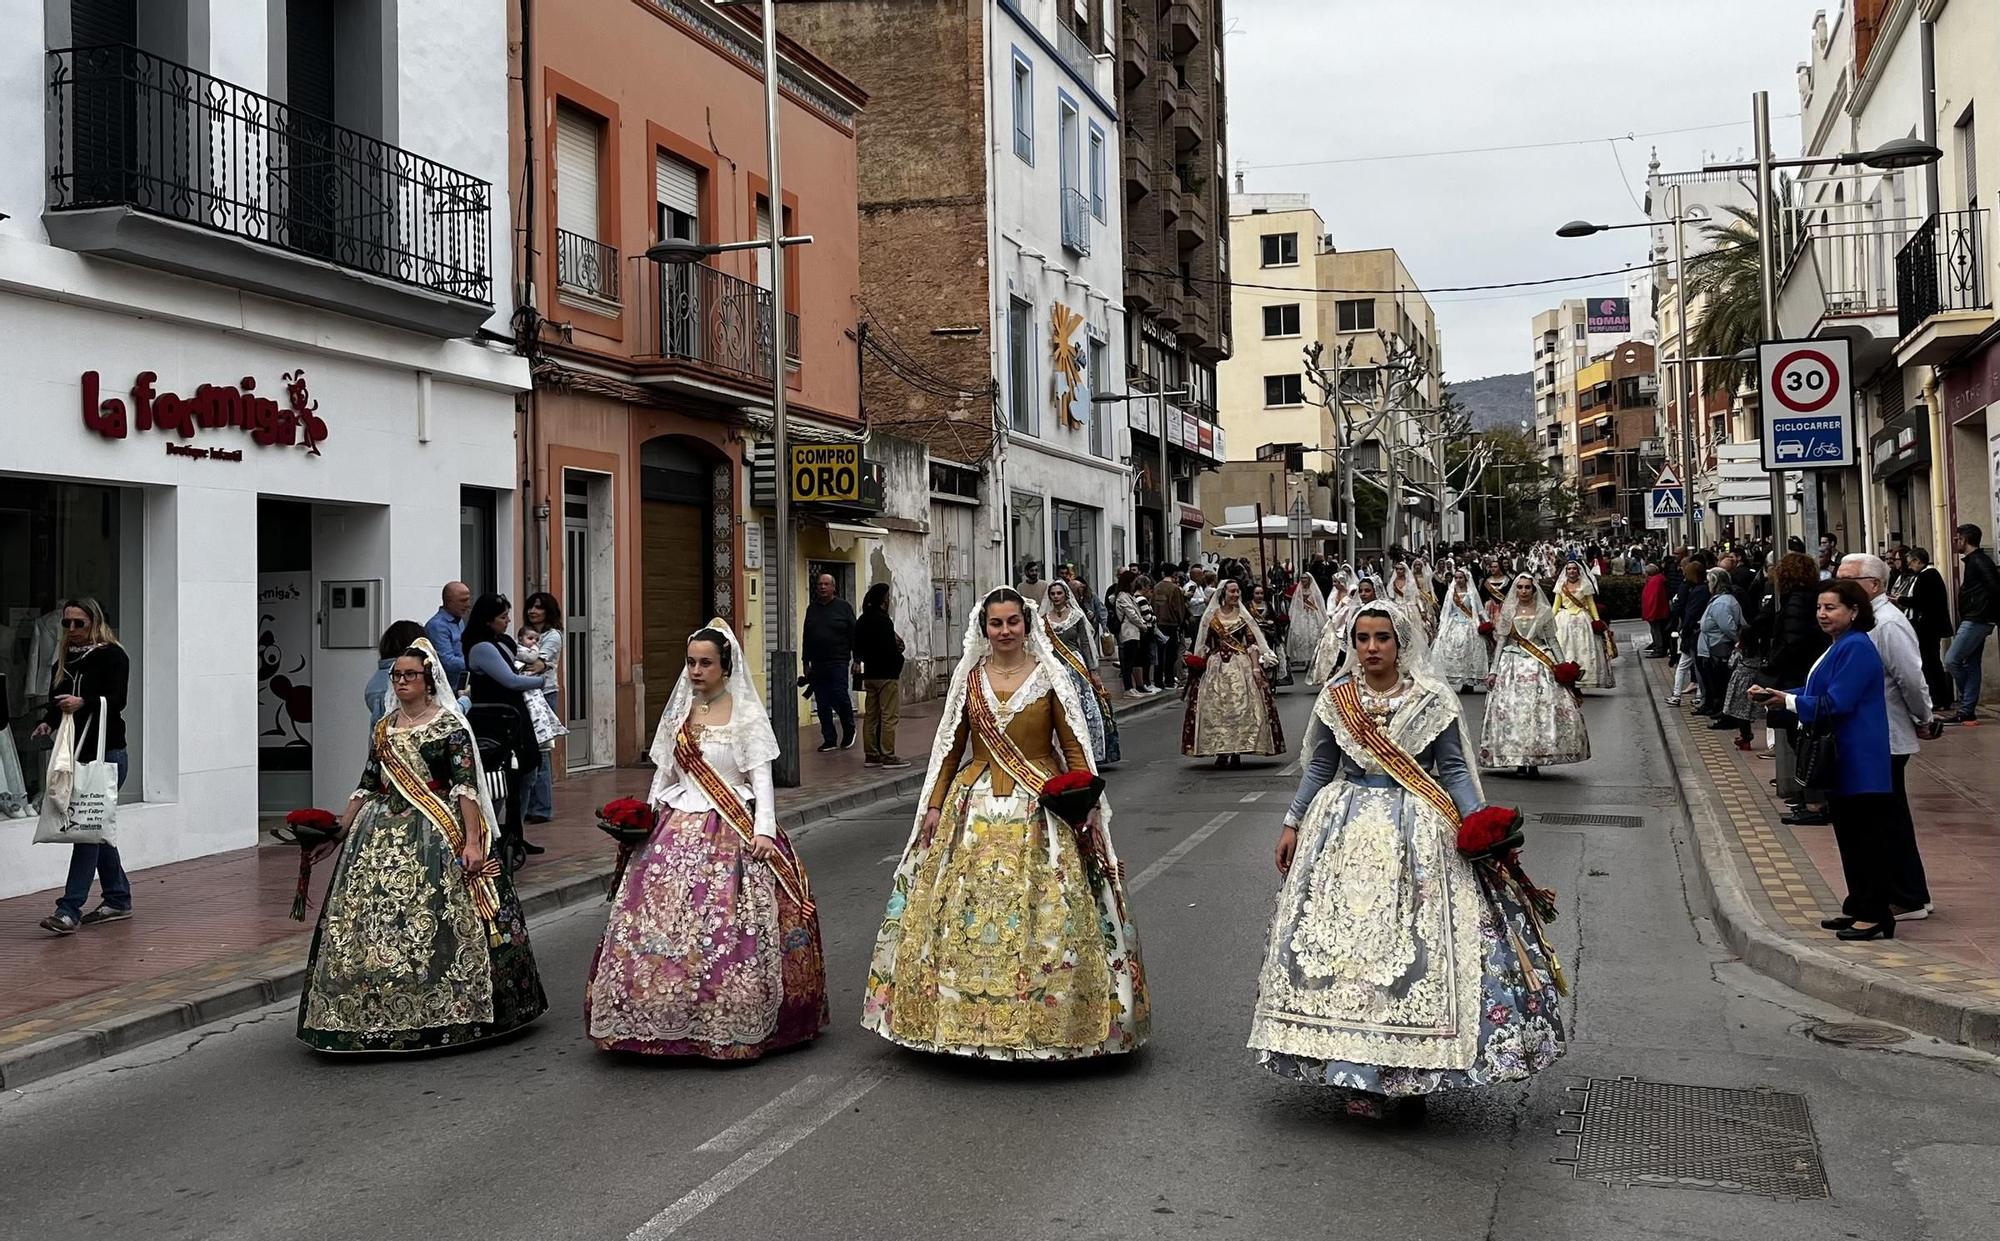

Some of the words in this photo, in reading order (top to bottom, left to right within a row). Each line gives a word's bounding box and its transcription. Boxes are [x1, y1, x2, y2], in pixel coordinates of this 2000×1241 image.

[1588, 316, 1630, 326] ROMAN
[1786, 370, 1824, 391] 30
[131, 370, 297, 446] formiga
[1774, 420, 1841, 432] CICLOCARRER
[796, 448, 855, 464] COMPRO
[796, 467, 855, 496] ORO
